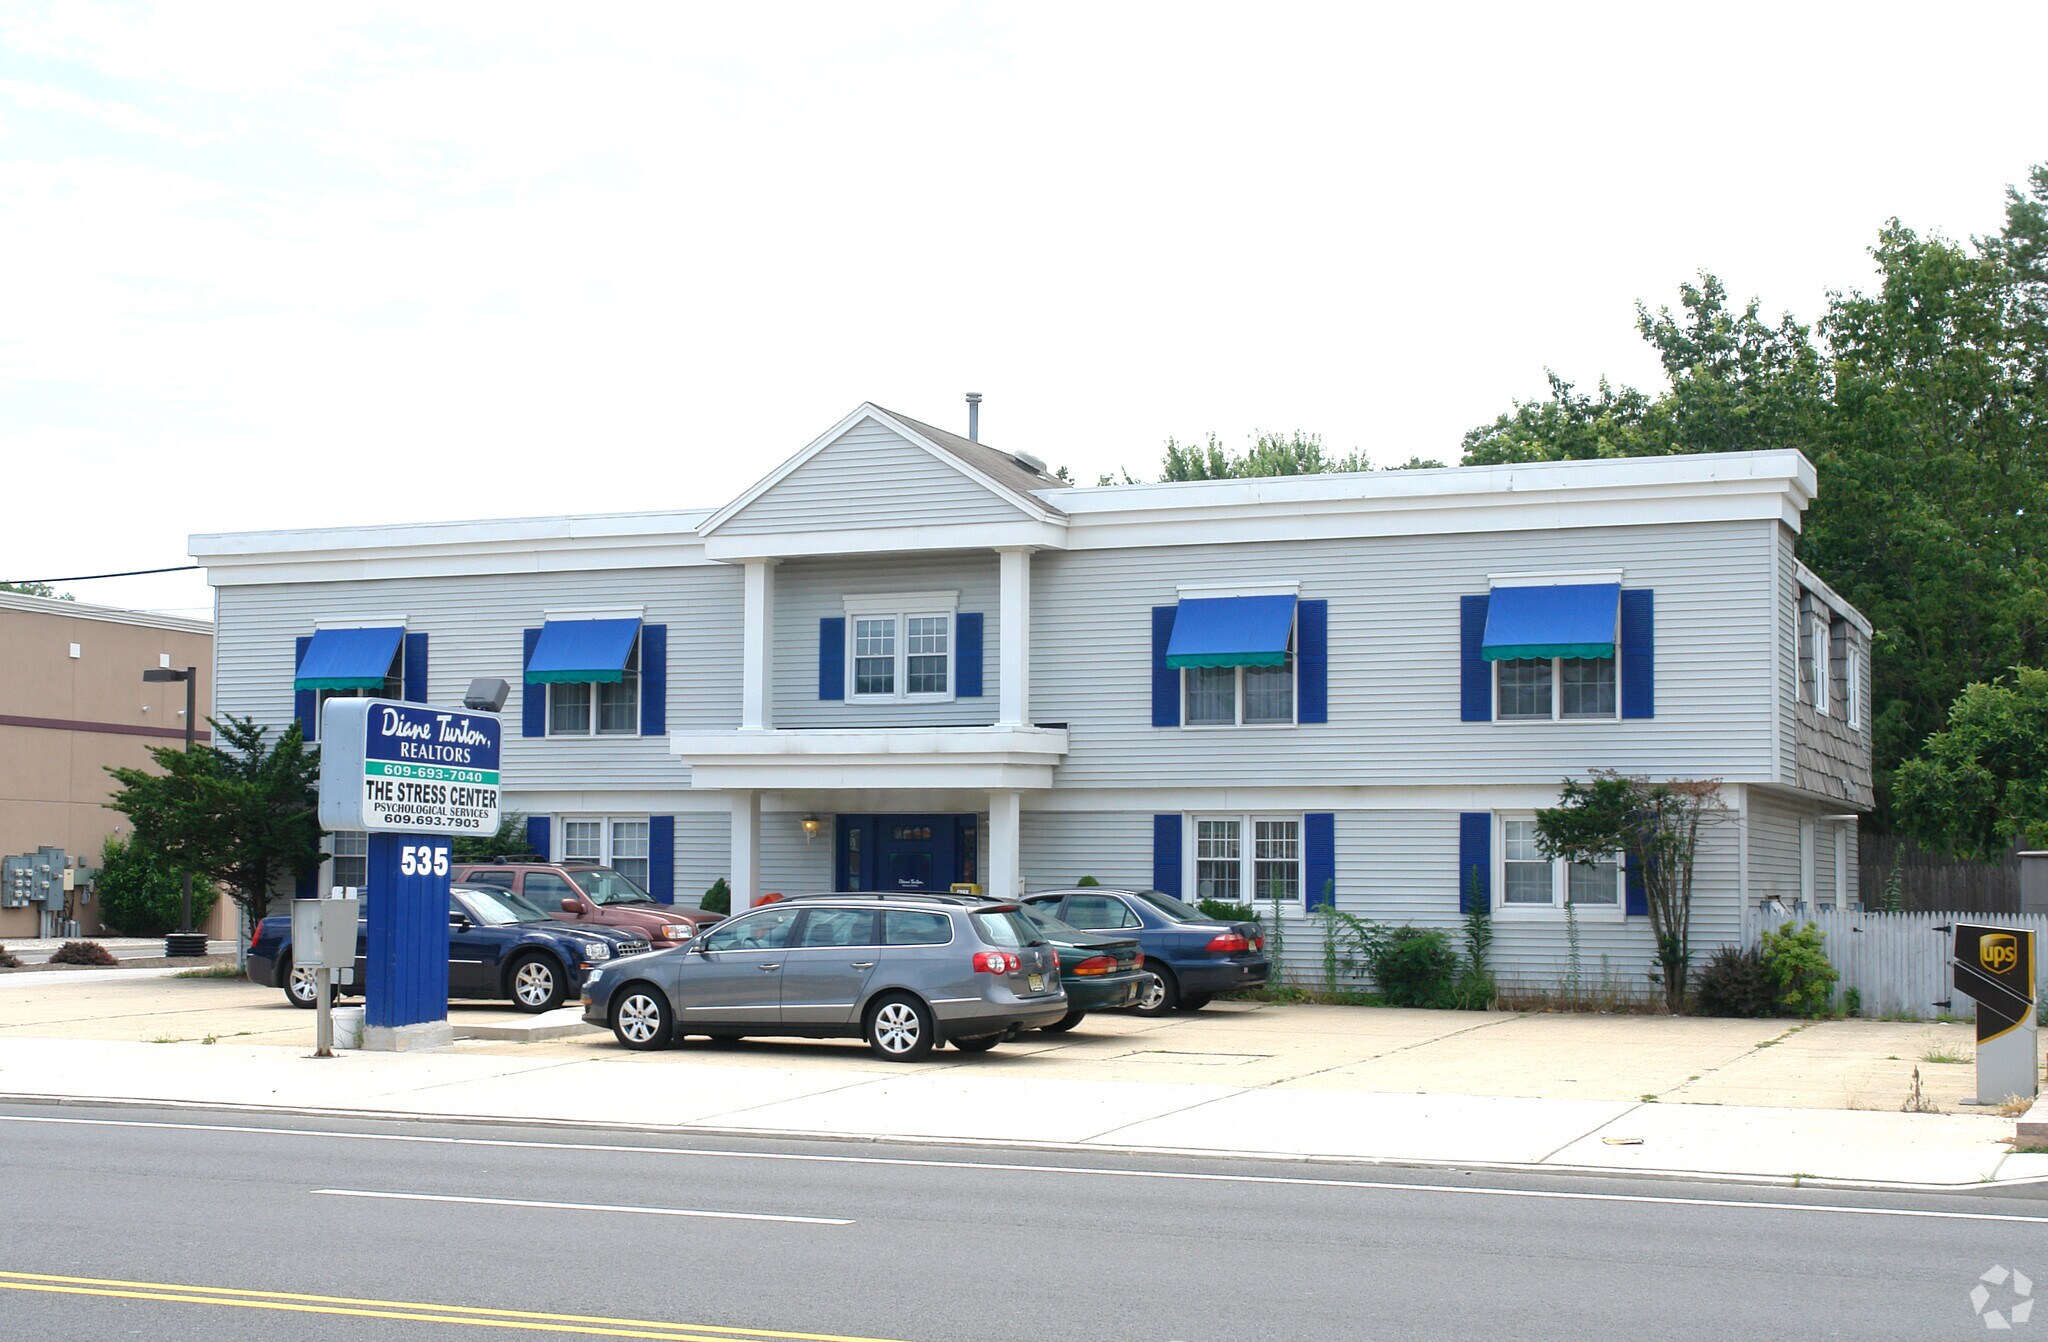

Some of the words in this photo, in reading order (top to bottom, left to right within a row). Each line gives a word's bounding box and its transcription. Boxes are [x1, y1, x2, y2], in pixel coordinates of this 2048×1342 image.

[381, 708, 431, 740] Diane
[400, 741, 471, 764] REALTORS
[383, 764, 483, 783] 609-693-7040
[366, 780, 394, 801] THE
[397, 782, 447, 805] STRESS
[450, 786, 497, 809] CENTER
[374, 802, 448, 816] PSYCHOLOGICAL
[449, 807, 489, 819] SERVICES
[384, 813, 480, 829] 609.693.7903
[400, 845, 449, 877] 535
[1983, 945, 2015, 968] ups
